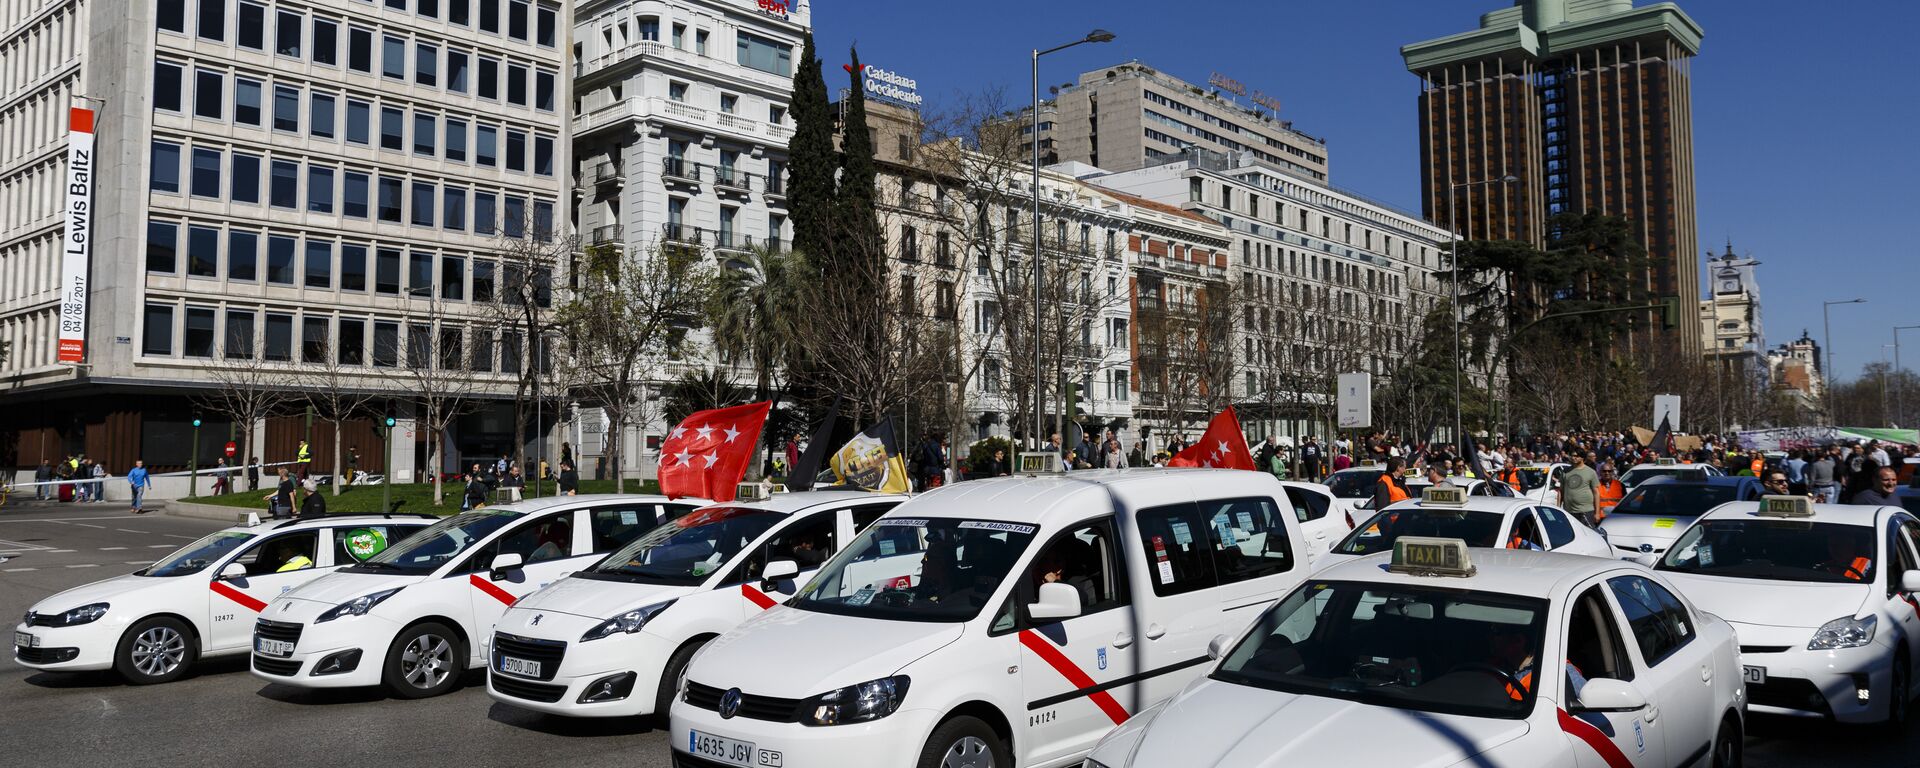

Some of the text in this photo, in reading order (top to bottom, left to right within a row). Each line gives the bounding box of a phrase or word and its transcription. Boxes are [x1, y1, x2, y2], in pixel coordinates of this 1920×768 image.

[865, 65, 917, 90] Catalana
[866, 79, 922, 105] Occidente
[67, 149, 89, 255] Lewis Baltz
[1024, 457, 1043, 470] TAXI
[1431, 491, 1453, 501] TAXI
[1771, 500, 1794, 511] TAXI
[1408, 544, 1441, 564] TAXI
[215, 614, 234, 622] 12472
[505, 658, 539, 676] 9700 JDX
[1029, 710, 1056, 727] 04124
[697, 736, 752, 764] 4635 JGV
[760, 751, 780, 765] SP
